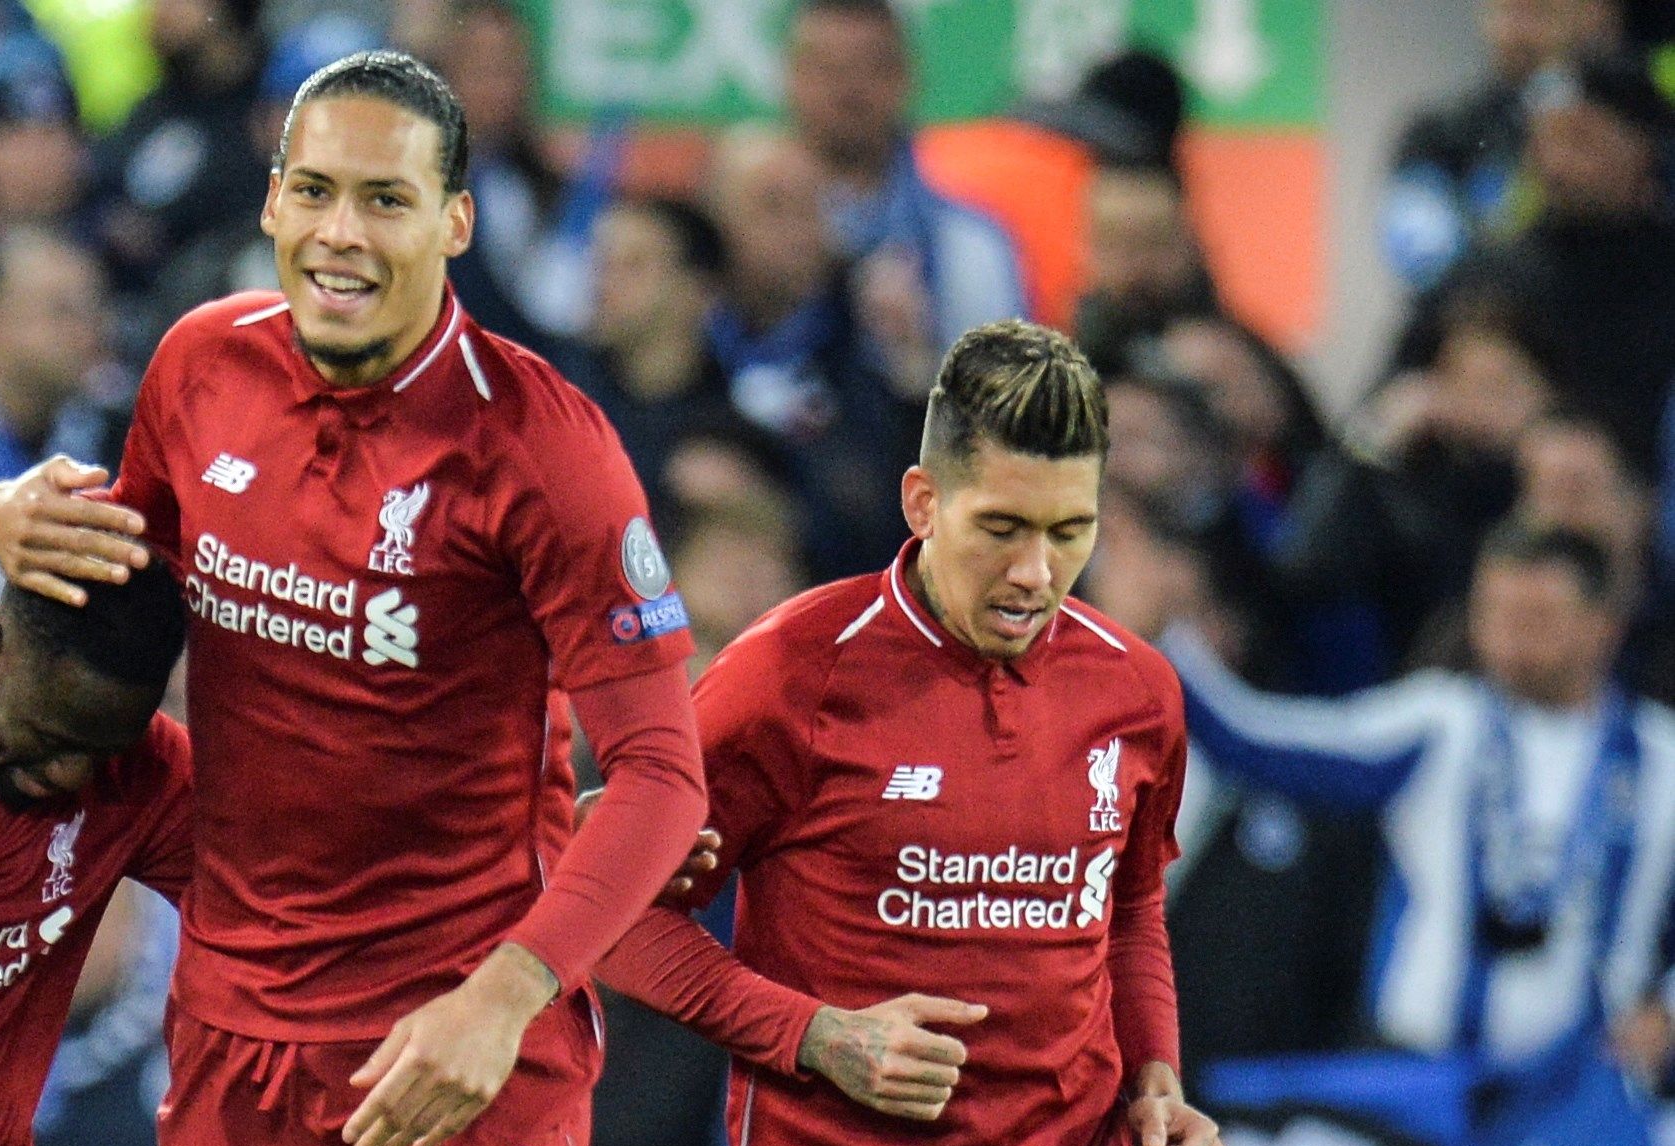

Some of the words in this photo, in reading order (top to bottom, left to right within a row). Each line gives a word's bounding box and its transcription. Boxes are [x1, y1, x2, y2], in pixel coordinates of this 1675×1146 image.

[194, 532, 356, 618] Standard
[185, 574, 353, 661] Chartered
[896, 845, 1077, 884] Standard
[877, 888, 1073, 928] Chartered
